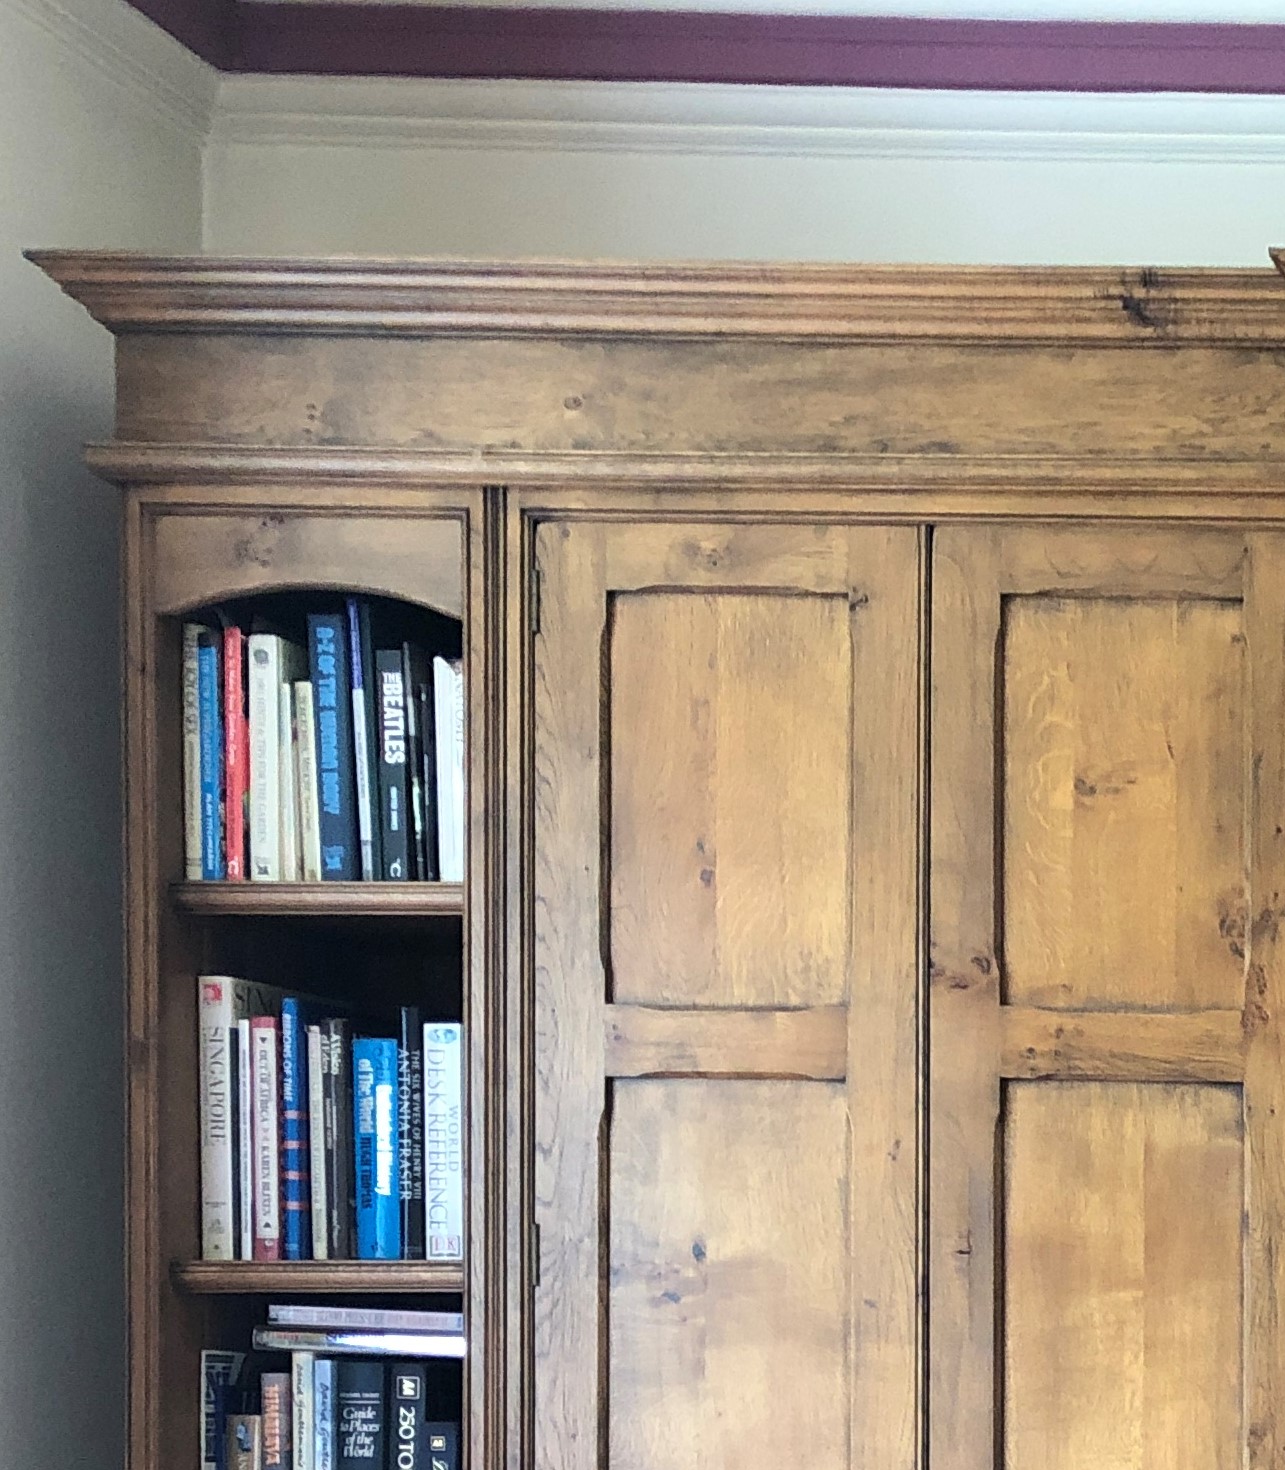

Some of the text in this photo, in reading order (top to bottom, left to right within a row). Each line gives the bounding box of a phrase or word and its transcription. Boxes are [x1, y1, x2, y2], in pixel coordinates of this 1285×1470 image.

[318, 655, 337, 674] OF
[319, 678, 338, 706] THE
[383, 683, 406, 764] BEATLES
[282, 1013, 293, 1101] RIBBONS OF TIME
[358, 1058, 374, 1073] of
[208, 1027, 227, 1147] SINGAPORE
[358, 1074, 374, 1096] The
[398, 1048, 412, 1200] ANTONIA FRASER
[411, 1049, 422, 1199] THE SIX WIVES OF HENRY VIII
[427, 1048, 449, 1230] DESK REFERENCE
[447, 1104, 459, 1172] WORLD
[318, 1382, 331, 1423] David
[343, 1406, 377, 1420] Guide
[398, 1406, 415, 1440] 250
[349, 1419, 380, 1432] Places
